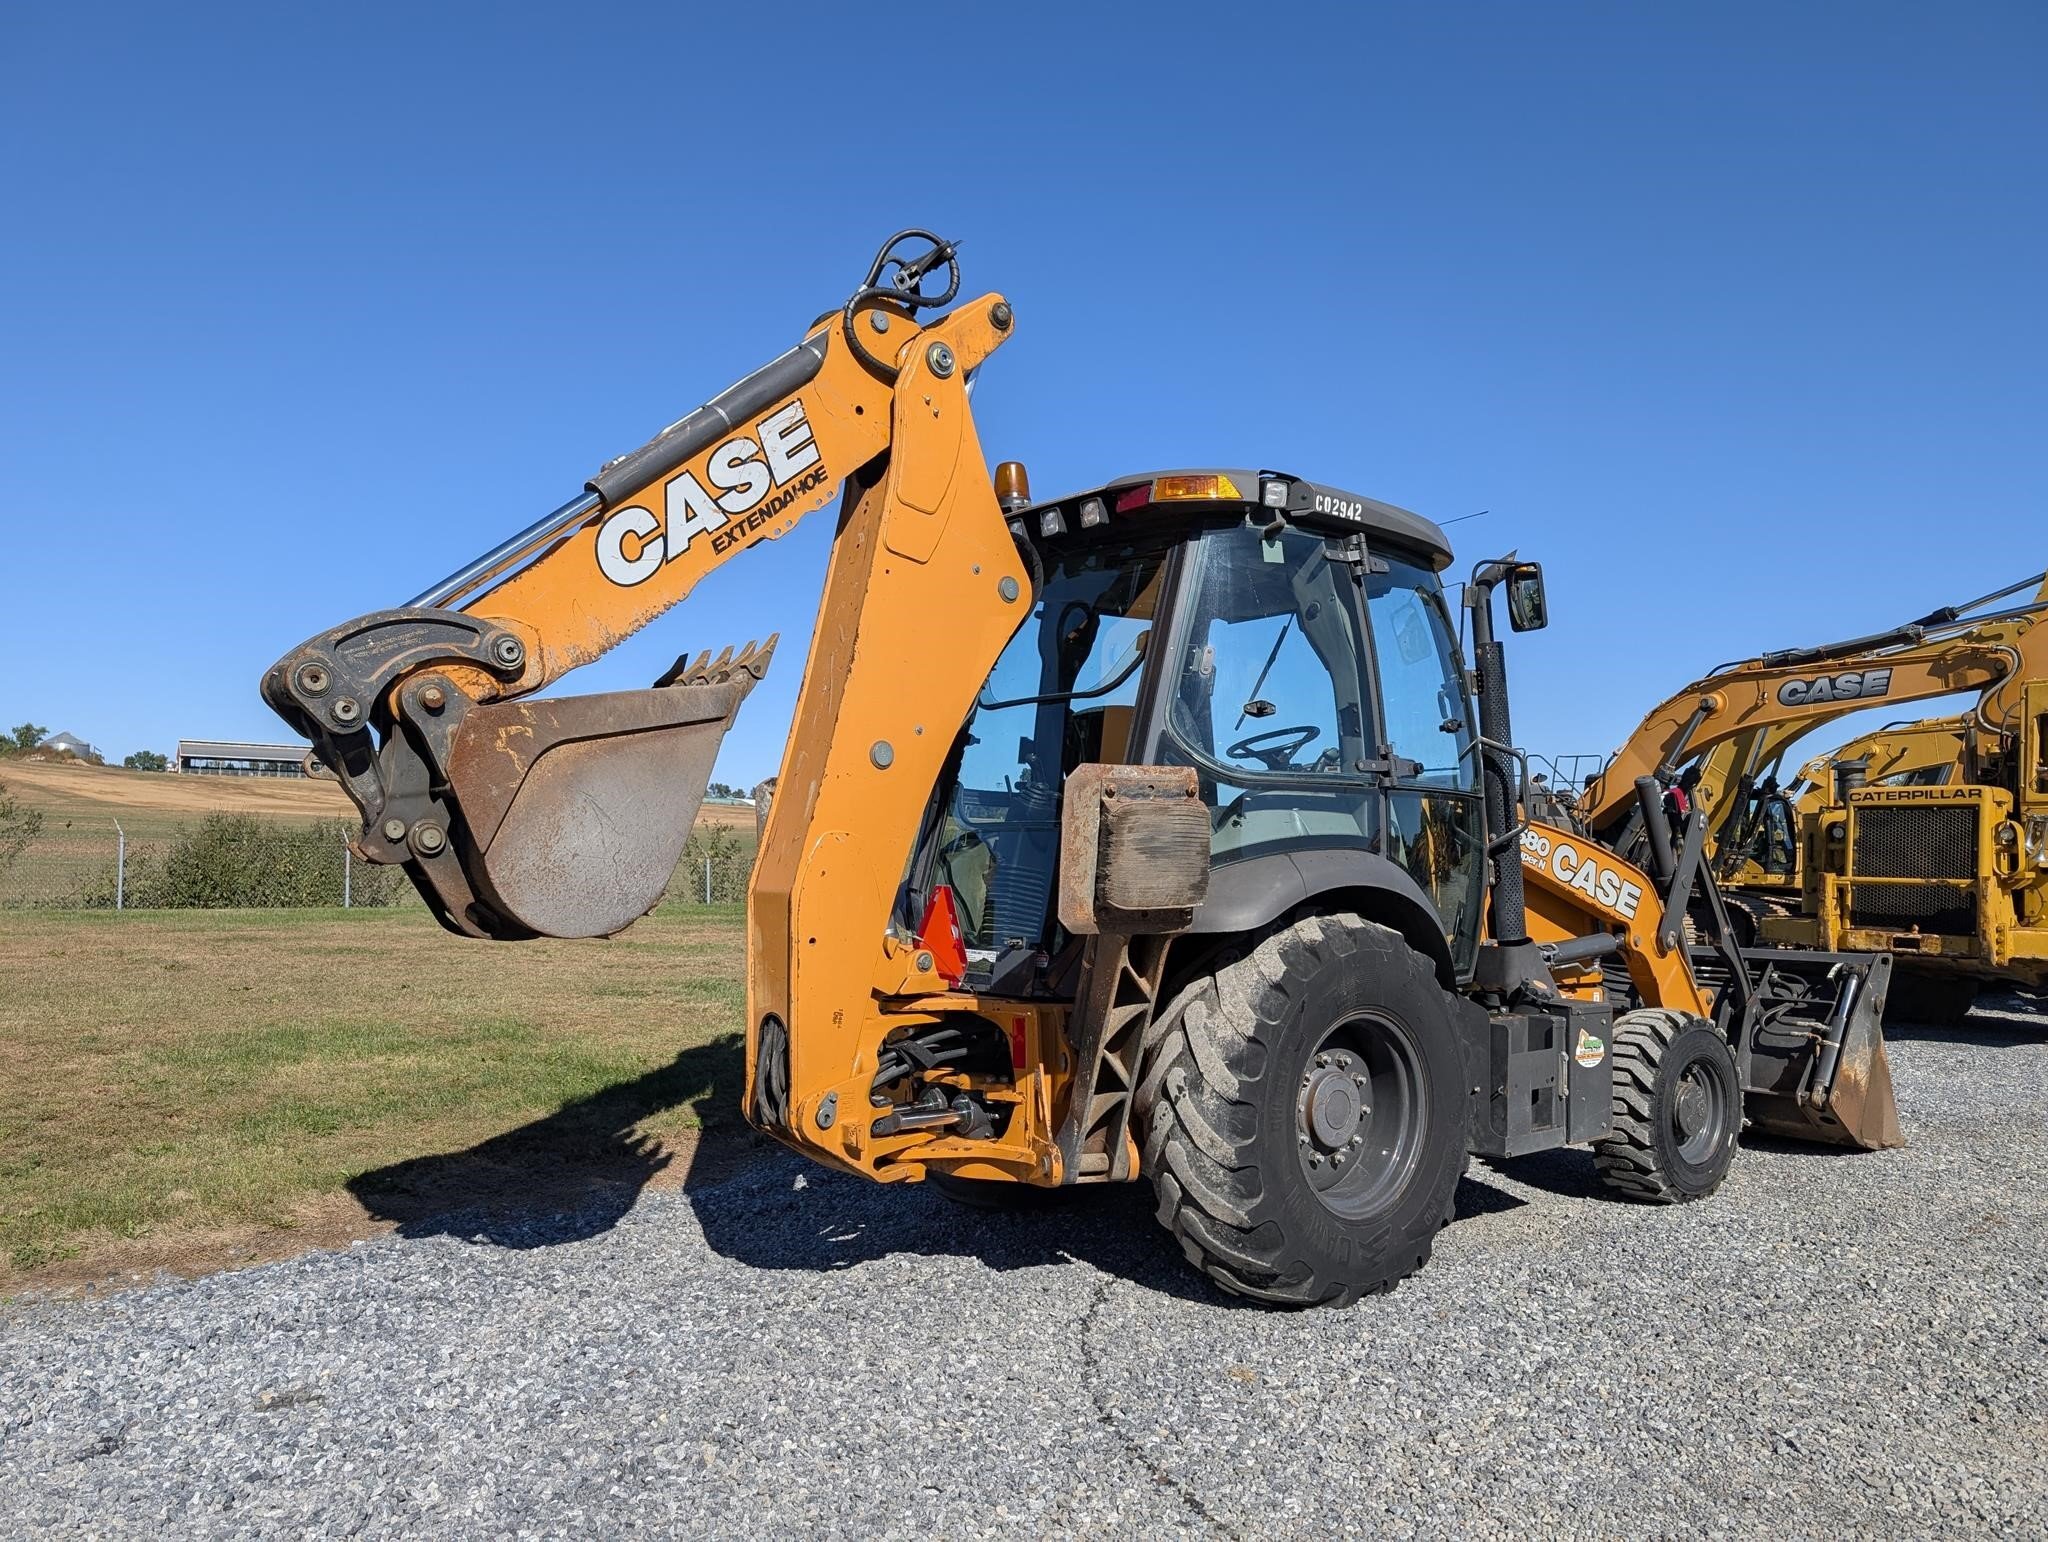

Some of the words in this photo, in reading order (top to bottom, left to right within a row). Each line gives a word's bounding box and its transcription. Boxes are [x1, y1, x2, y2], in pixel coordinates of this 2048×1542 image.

[595, 398, 821, 587] CASE
[711, 465, 828, 556] EXTENDAHOE
[1777, 668, 1893, 706] CASE
[1850, 789, 1982, 802] CATERPILLAR
[1520, 852, 1539, 867] uper
[1552, 843, 1642, 920] CASE
